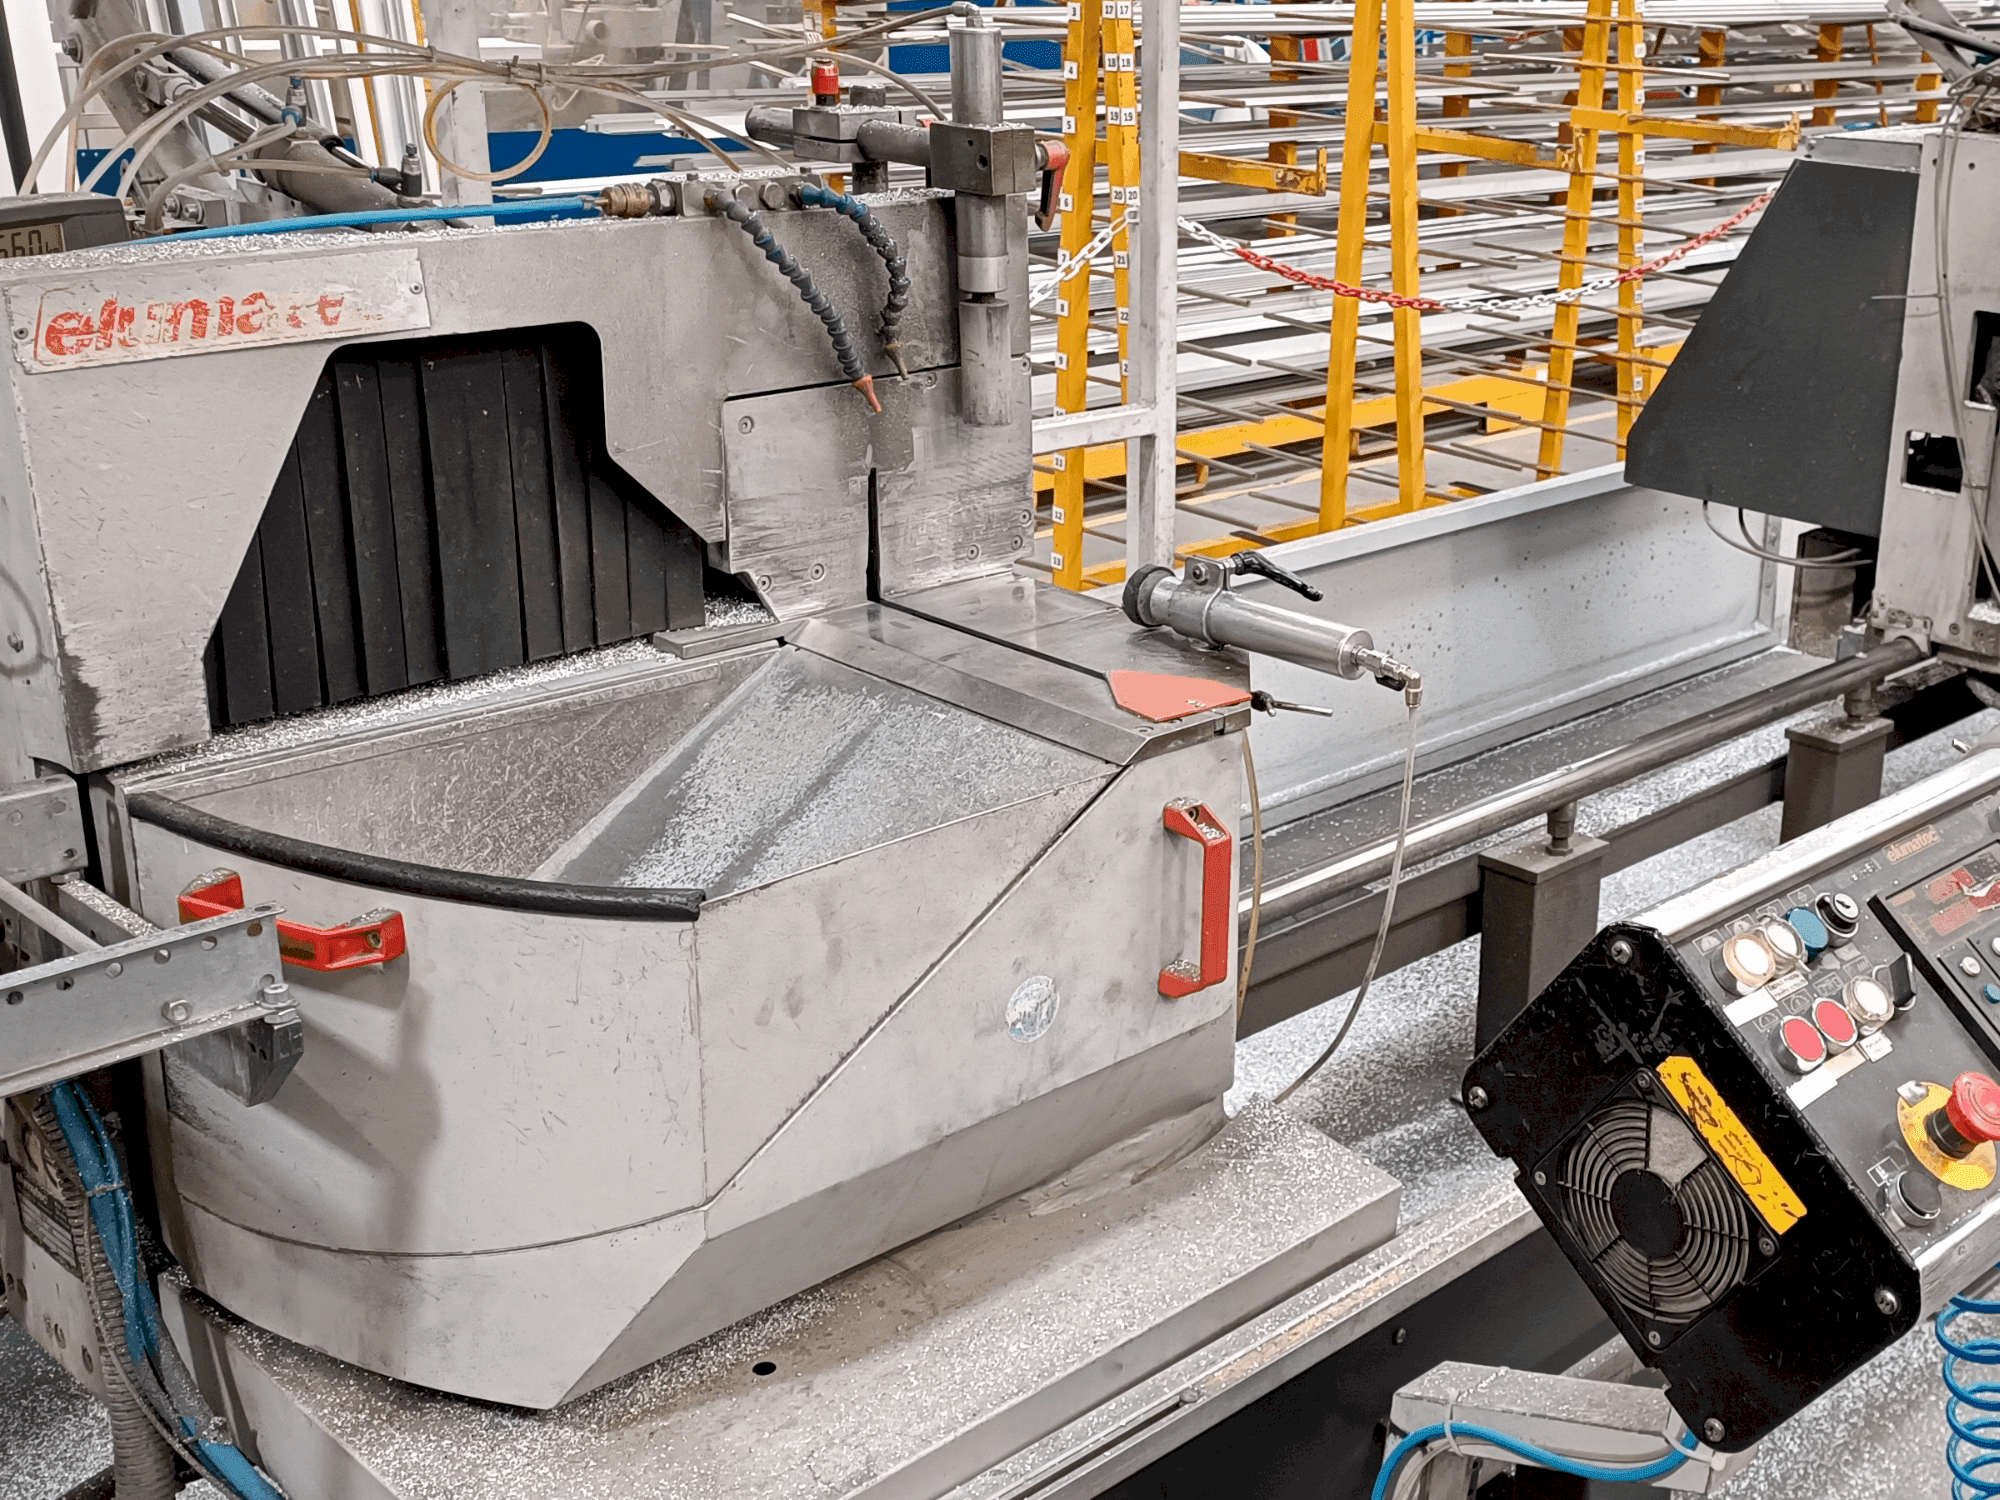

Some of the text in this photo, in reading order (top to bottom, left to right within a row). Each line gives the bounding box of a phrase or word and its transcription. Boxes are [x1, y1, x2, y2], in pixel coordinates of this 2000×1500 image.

[1104, 4, 1115, 15] 17
[1119, 4, 1130, 15] 17
[1106, 57, 1117, 68] 18
[1121, 57, 1132, 68] 18
[1109, 111, 1119, 121] 19
[1123, 111, 1134, 122] 19
[1113, 190, 1123, 201] 20
[1127, 190, 1138, 201] 20
[1116, 254, 1126, 265] 21
[1120, 311, 1129, 321] 22
